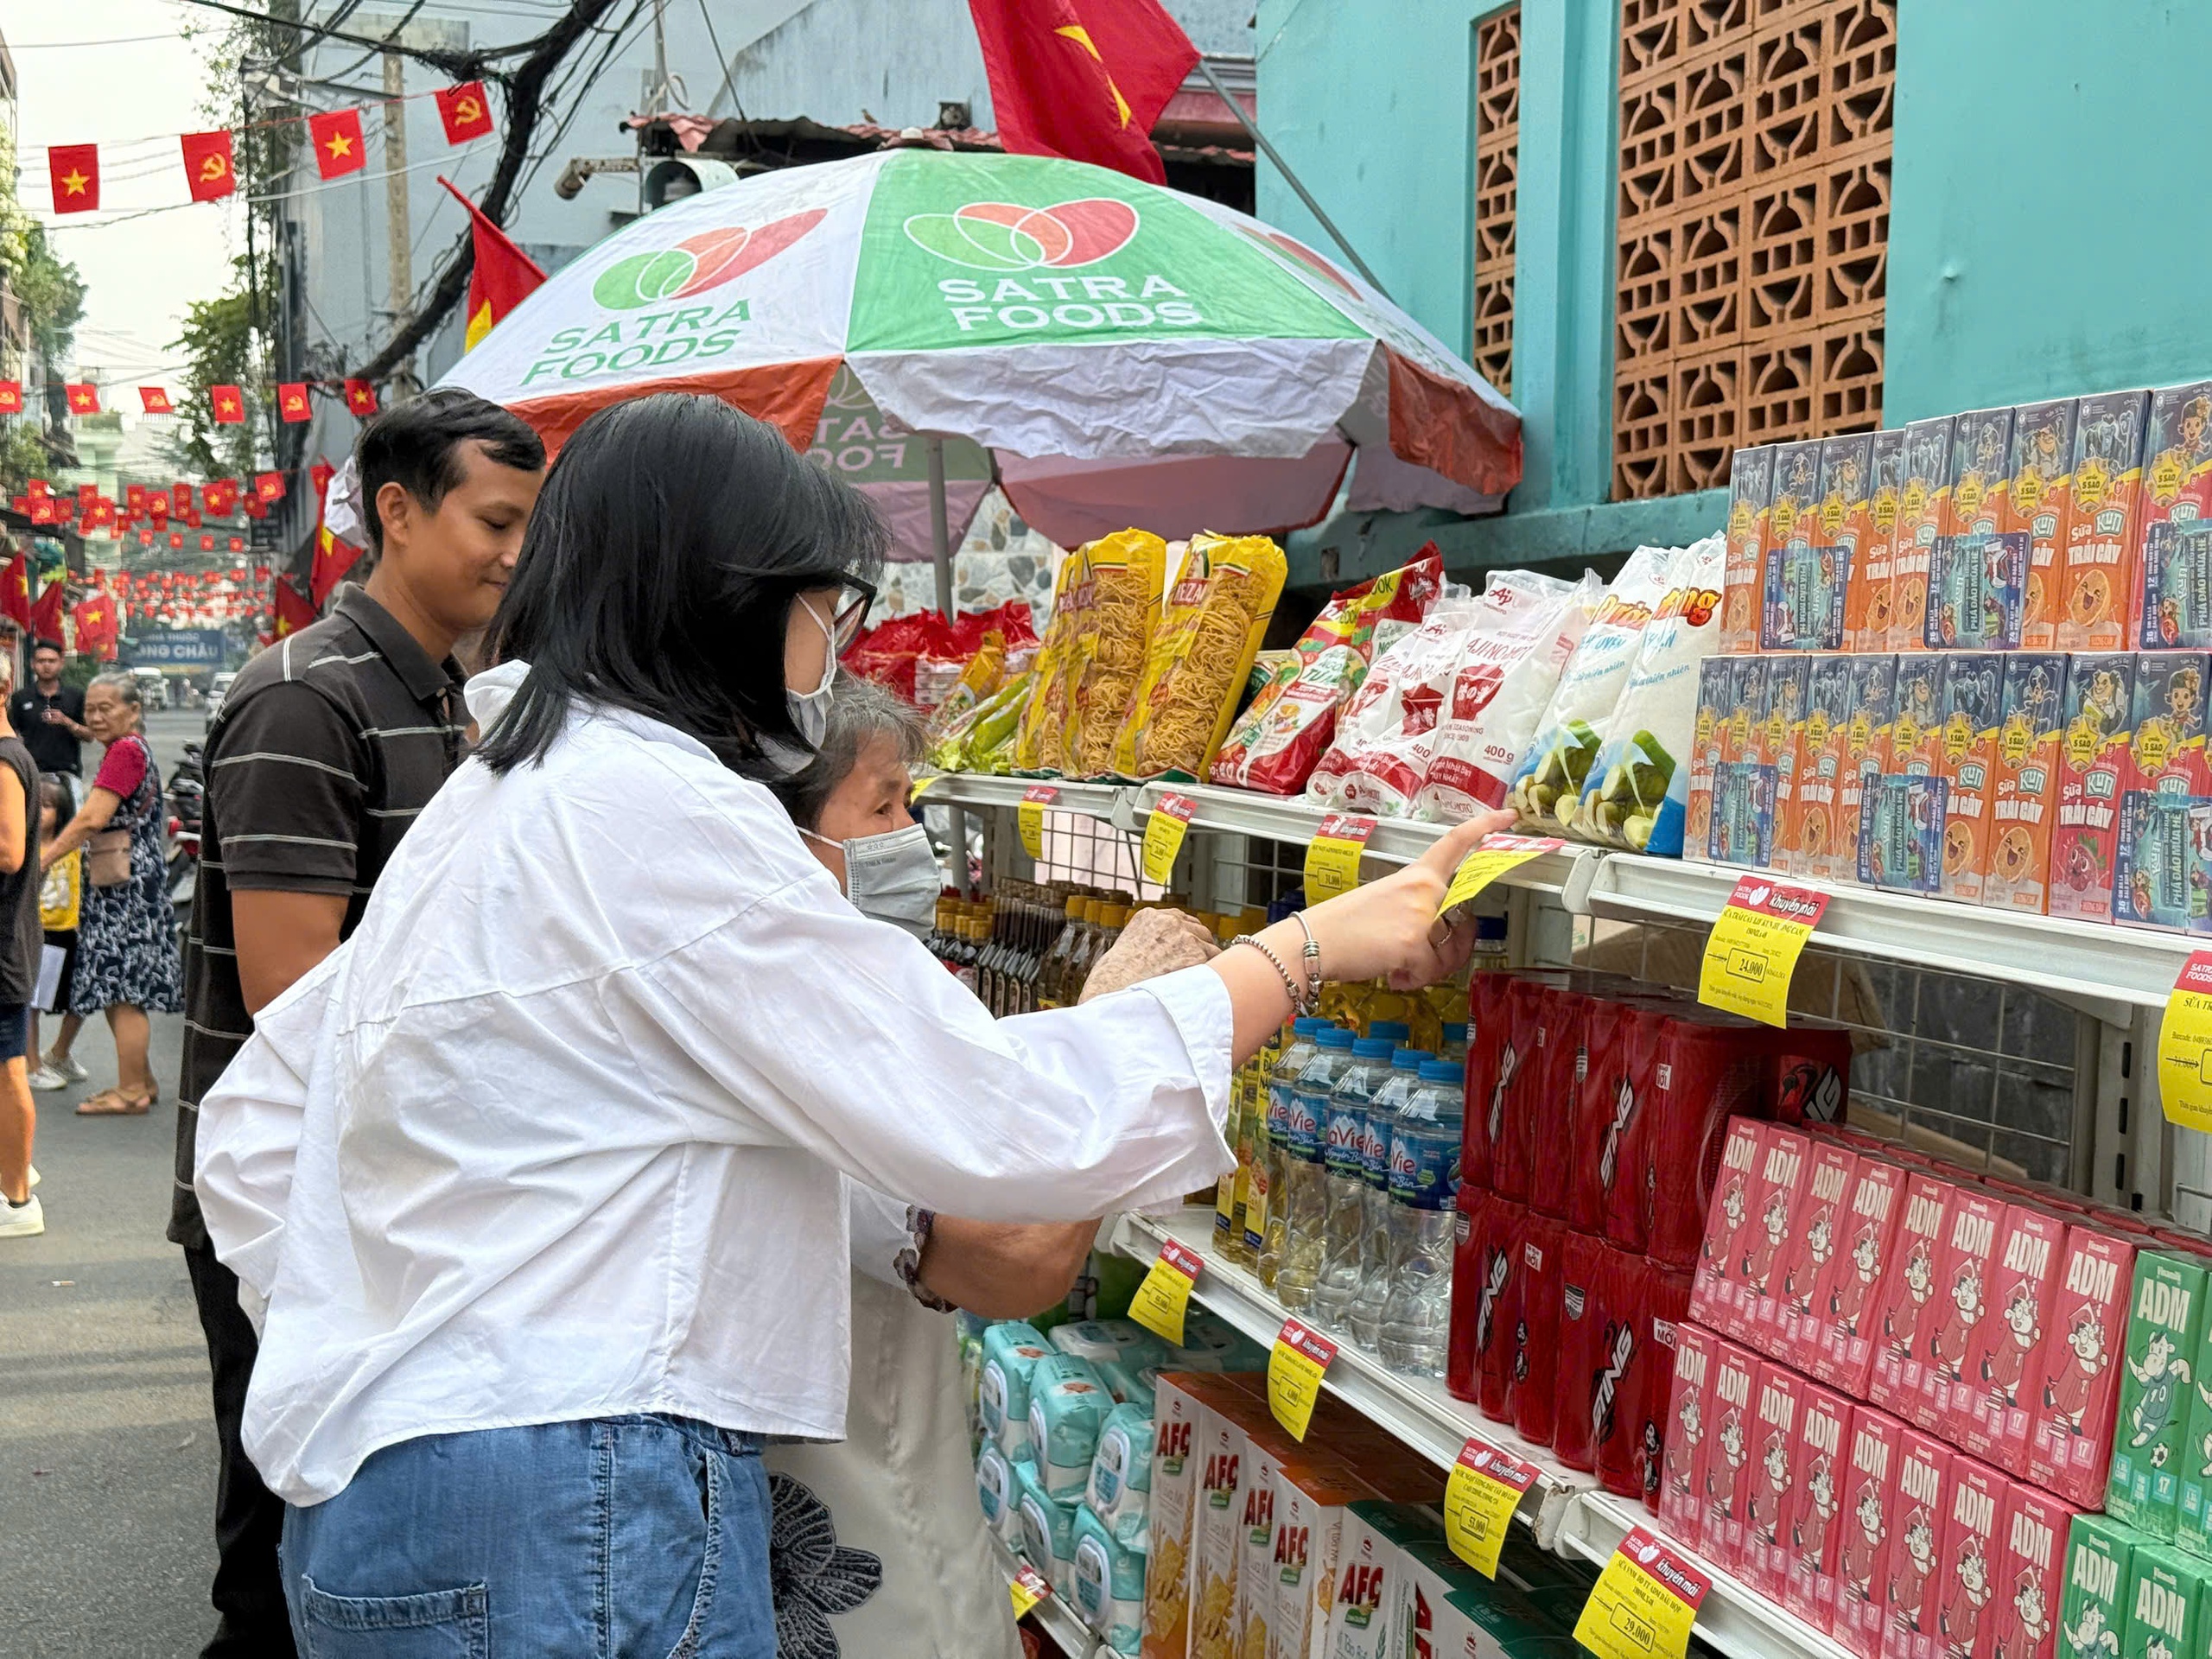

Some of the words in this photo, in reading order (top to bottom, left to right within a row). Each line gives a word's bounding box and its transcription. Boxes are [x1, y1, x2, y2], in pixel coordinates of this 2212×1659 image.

[938, 274, 1190, 302] SATRA
[543, 298, 752, 353] SATRA
[949, 301, 1203, 331] FOODS
[518, 329, 741, 385] FOODS
[1866, 559, 1891, 580] TRÁ
[2068, 539, 2094, 566] TRÁI
[2095, 538, 2122, 565] CÂY
[1484, 745, 1504, 757] 400
[1507, 752, 1514, 763] g
[2060, 799, 2086, 826] TRÁI
[2086, 802, 2114, 831] CÂY
[2171, 813, 2181, 828] HÈ
[2171, 830, 2181, 855] MÙA
[2171, 857, 2182, 880] ĐẢO
[1769, 892, 1800, 914] khuyến
[1799, 901, 1820, 917] mãi
[2171, 881, 2183, 906] PHÁ
[1738, 958, 1763, 976] 24.000
[1269, 1099, 1288, 1119] Vie
[1289, 1108, 1316, 1132] Vie
[1327, 1125, 1364, 1149] aVie
[1363, 1134, 1384, 1158] Vie
[1723, 1134, 1758, 1174] ADM
[1391, 1150, 1416, 1174] Vie
[1763, 1147, 1801, 1190] ADM
[1811, 1162, 1847, 1205] ADM
[1852, 1178, 1894, 1223] ADM
[1904, 1194, 1943, 1241] ADM
[1950, 1211, 1995, 1260] ADM
[2003, 1230, 2051, 1281] ADM
[2065, 1250, 2119, 1306] ADM
[2137, 1277, 2191, 1334] ADM
[1675, 1344, 1707, 1389] ADM
[1716, 1363, 1751, 1410] ADM
[1958, 1387, 1967, 1401] 17
[2150, 1384, 2167, 1403] 10
[1758, 1384, 1795, 1433] ADM
[2013, 1414, 2022, 1427] 17
[1156, 1421, 1192, 1458] AFC
[1803, 1408, 1840, 1458] ADM
[2077, 1441, 2088, 1458] 17
[1203, 1454, 1239, 1491] AFC
[1490, 1459, 1514, 1478] khuyến
[1853, 1429, 1890, 1482] ADM
[1900, 1454, 1940, 1510] ADM
[2158, 1476, 2171, 1495] 17
[1953, 1481, 1995, 1539] ADM
[1274, 1526, 1309, 1566] AFC
[2009, 1510, 2054, 1571] ADM
[1338, 1563, 1384, 1608] AFC
[1656, 1557, 1684, 1589] khuyến
[1681, 1580, 1701, 1597] mãi
[2072, 1543, 2119, 1605] ADM
[2134, 1577, 2186, 1642] ADM
[1623, 1618, 1650, 1645] 29.000
